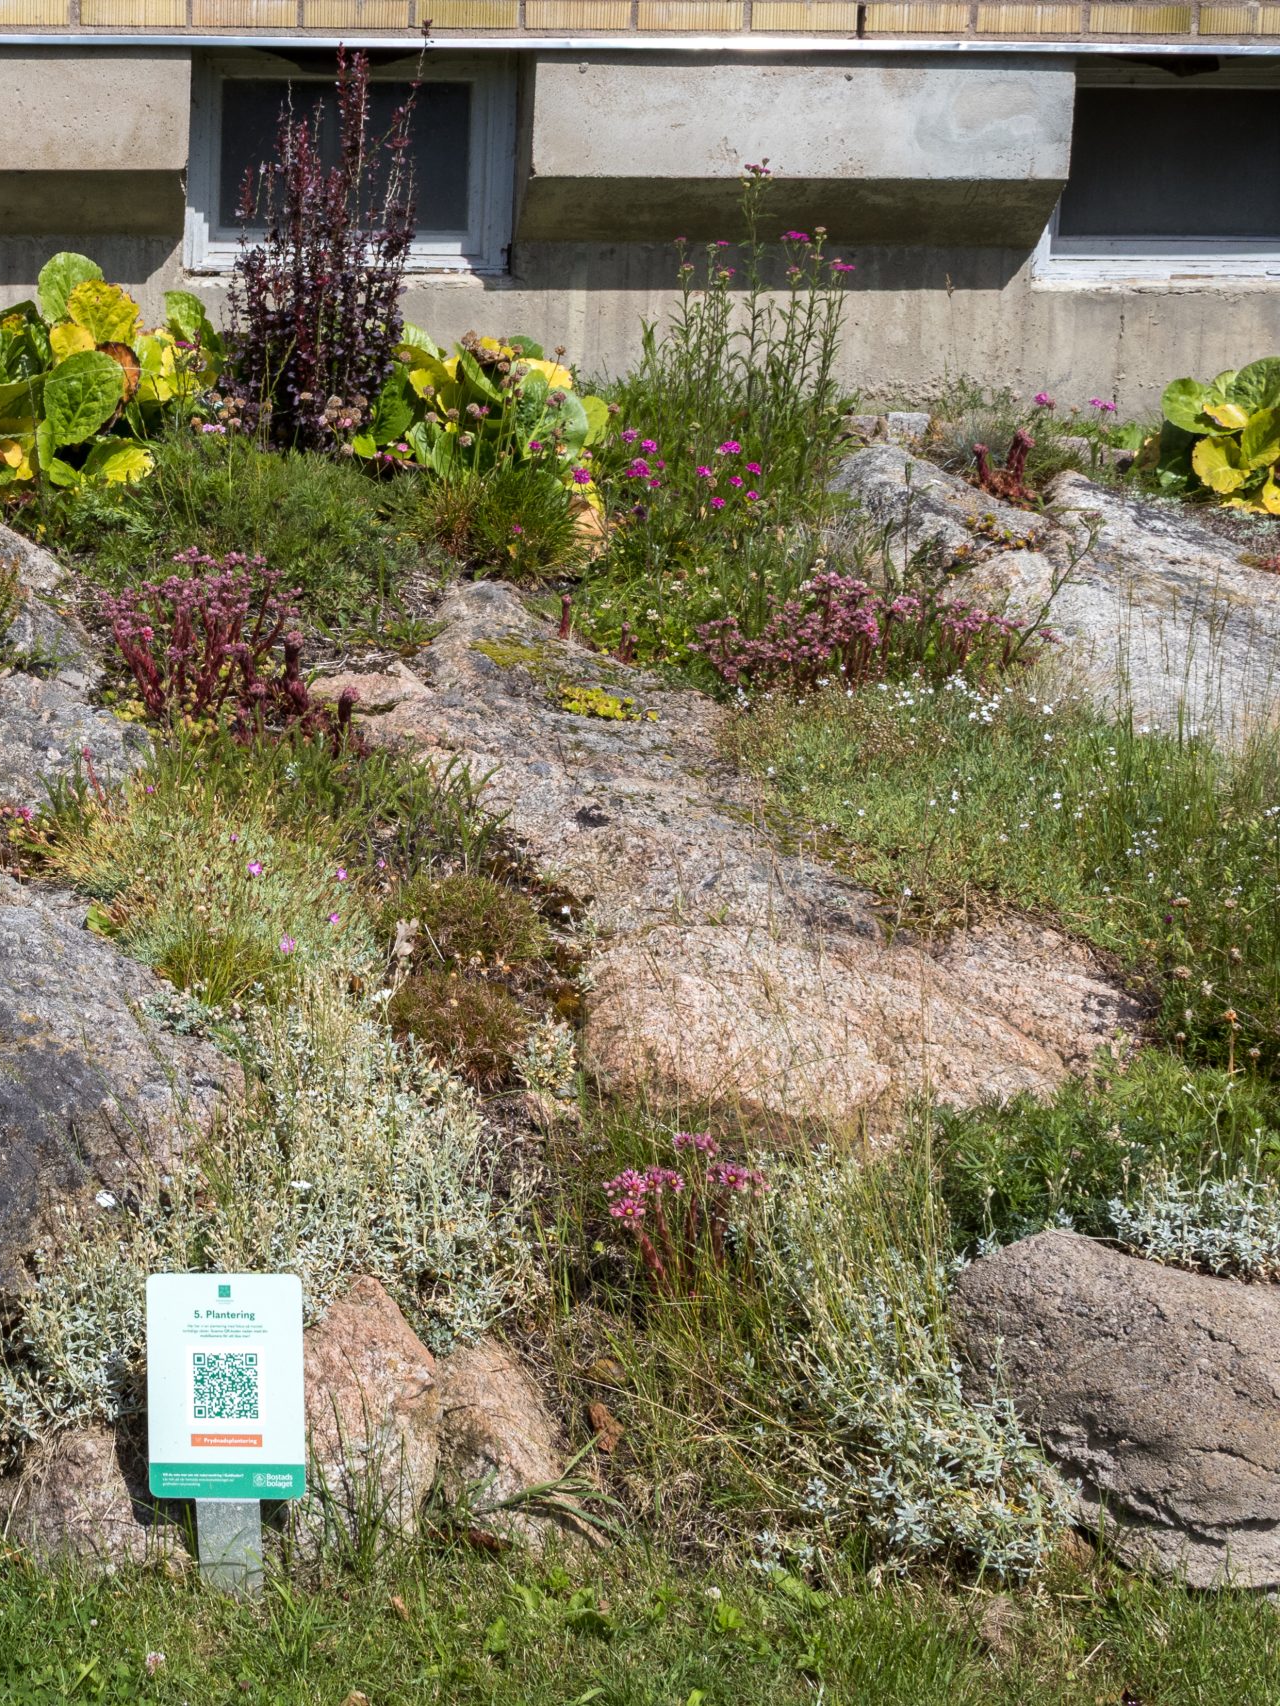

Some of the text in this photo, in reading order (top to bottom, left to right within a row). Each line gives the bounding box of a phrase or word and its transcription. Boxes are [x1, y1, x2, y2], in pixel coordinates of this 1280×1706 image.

[194, 1309, 255, 1321] 5. Plantering
[203, 1436, 257, 1445] Prydnadsplantering
[266, 1473, 293, 1481] Bostads
[266, 1480, 293, 1489] bolaget
